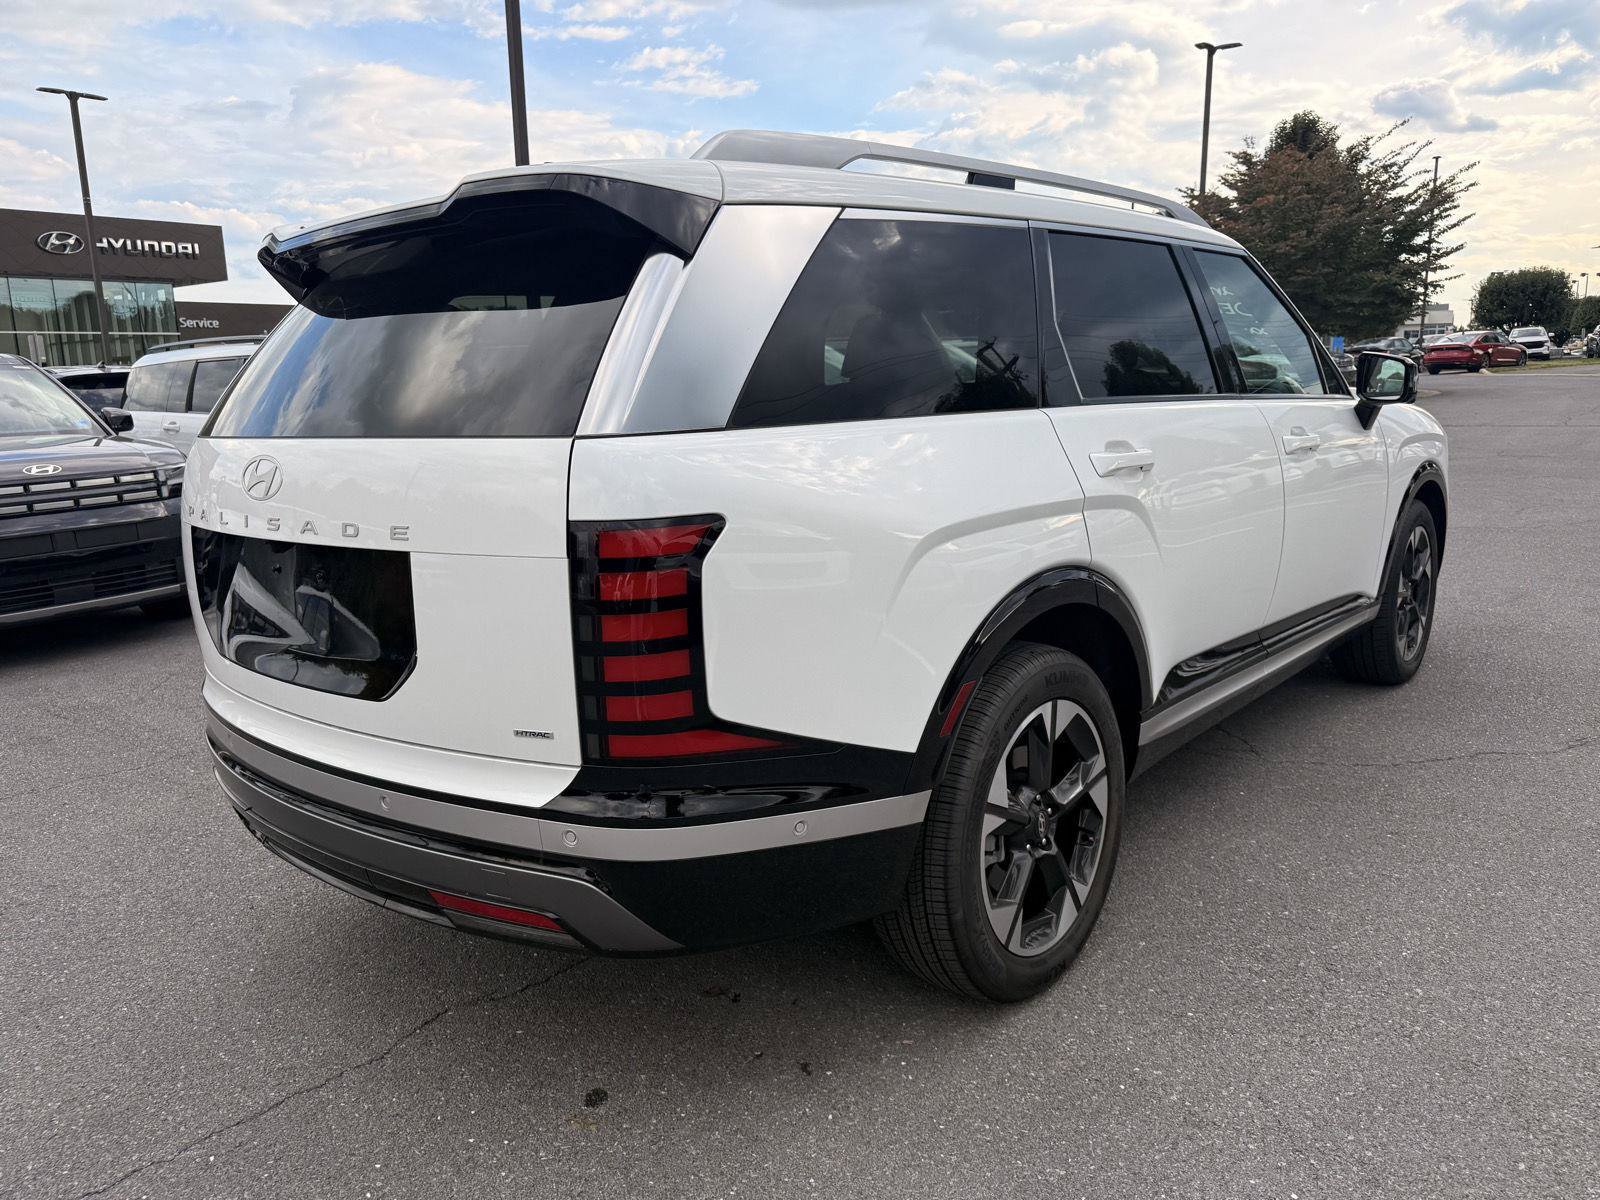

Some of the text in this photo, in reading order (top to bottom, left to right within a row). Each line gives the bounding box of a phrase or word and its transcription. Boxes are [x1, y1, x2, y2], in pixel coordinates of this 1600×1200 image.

[179, 317, 220, 329] Service
[187, 505, 410, 542] PALISADE
[514, 729, 552, 739] HTRAC
